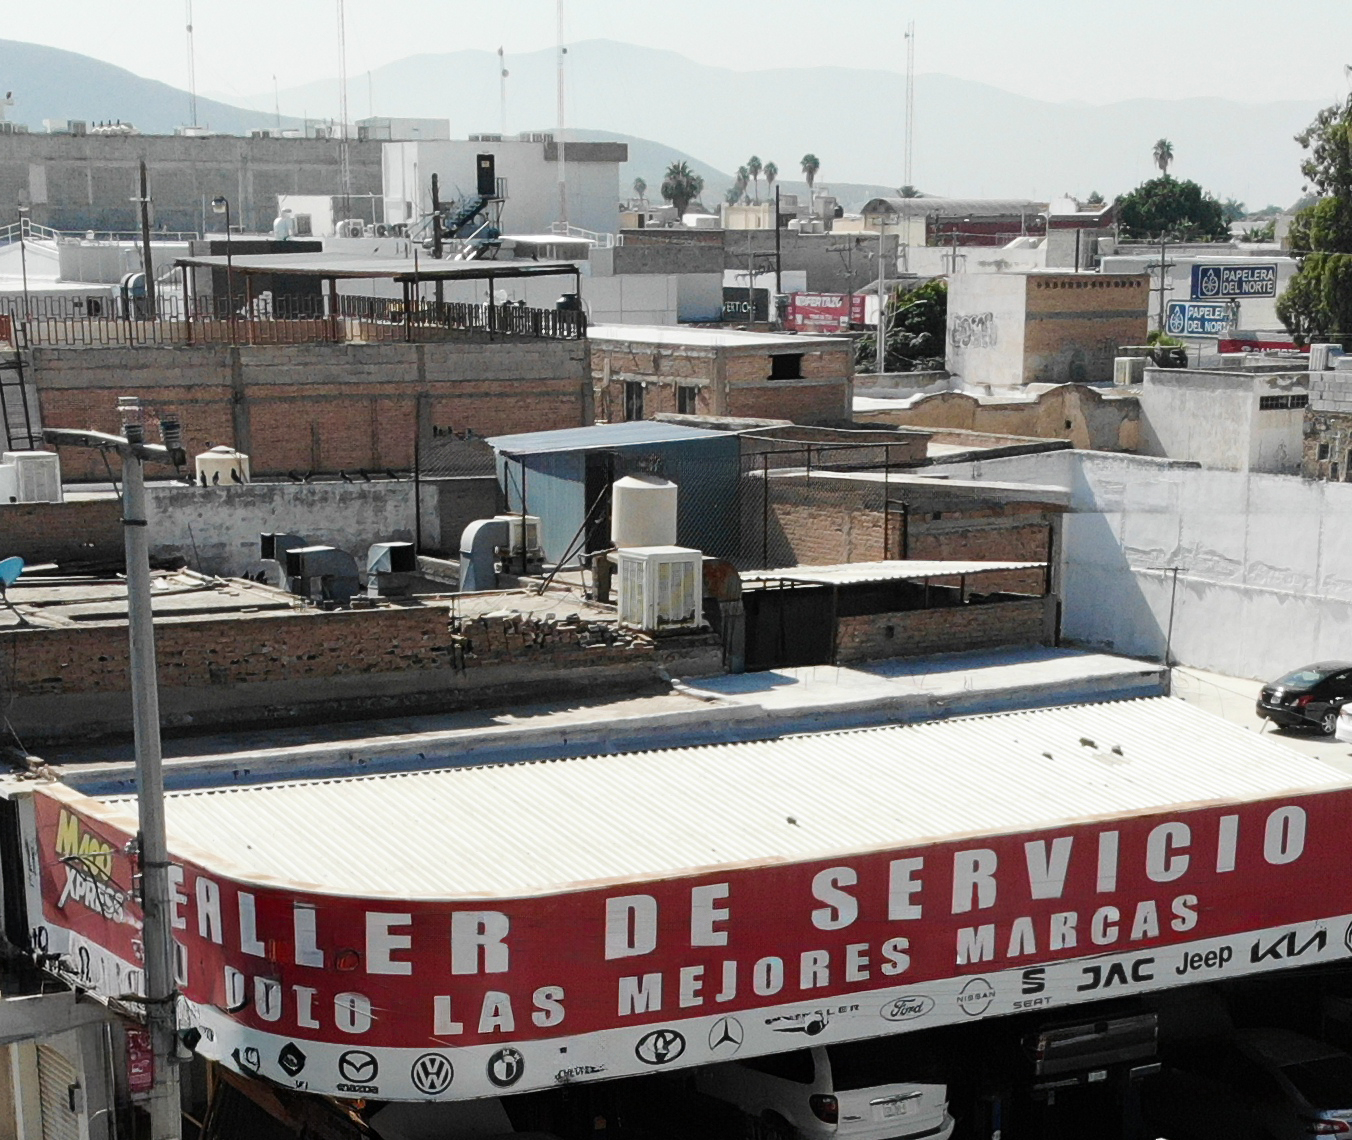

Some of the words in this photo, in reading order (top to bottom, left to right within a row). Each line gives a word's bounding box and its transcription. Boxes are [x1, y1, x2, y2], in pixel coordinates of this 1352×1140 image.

[1223, 269, 1275, 281] PAPELERA
[1222, 282, 1240, 294] DEL
[1242, 281, 1274, 293] NORTE
[1187, 321, 1203, 333] DEL
[605, 882, 729, 960] DE
[811, 805, 1307, 930] SERVICIO
[433, 985, 566, 1035] LAS
[618, 937, 910, 1016] MEJORES
[956, 894, 1199, 965] MARCAS
[1175, 945, 1233, 976] Jeep
[1077, 957, 1155, 992] JAC
[956, 989, 996, 1004] NISSAN
[1013, 996, 1052, 1010] SEAT
[890, 998, 925, 1017] Ford
